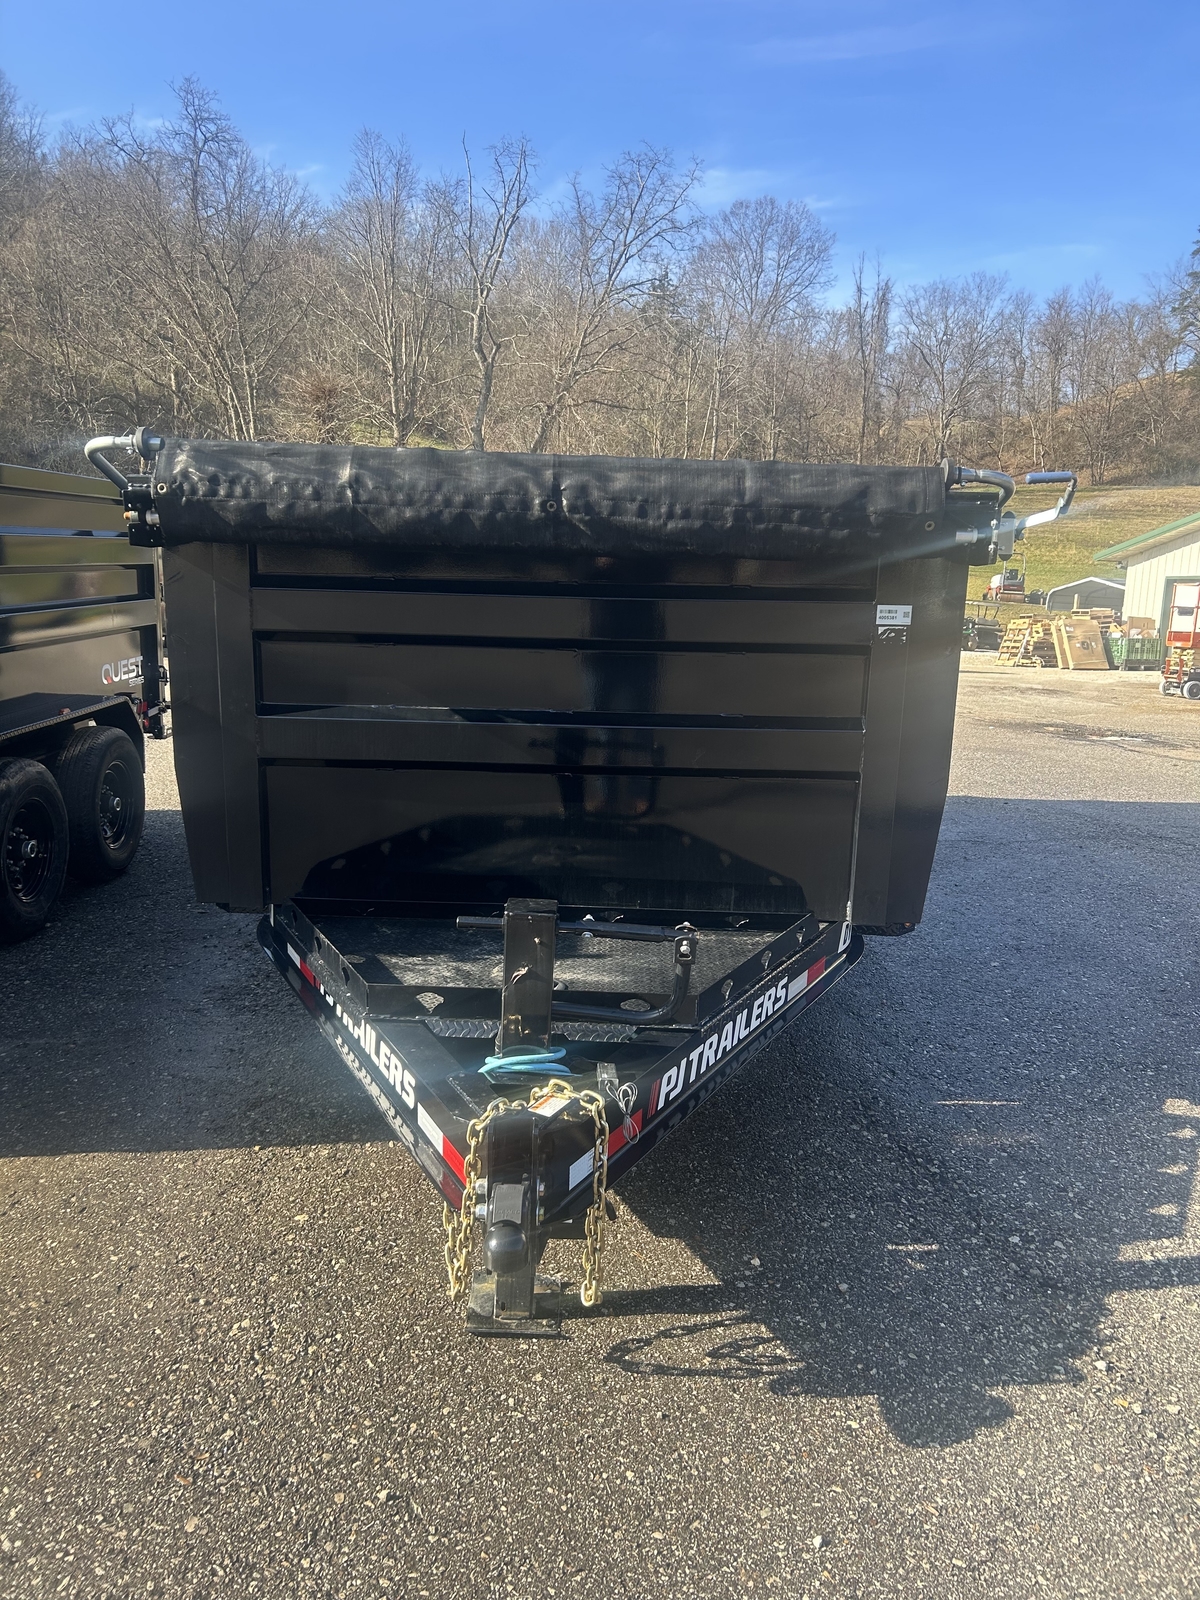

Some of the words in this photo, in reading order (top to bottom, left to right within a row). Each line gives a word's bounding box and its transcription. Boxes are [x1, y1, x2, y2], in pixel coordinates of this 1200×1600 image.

[101, 655, 144, 685] QUEST
[657, 1057, 687, 1111] PJ
[689, 975, 789, 1084] TRAILERS
